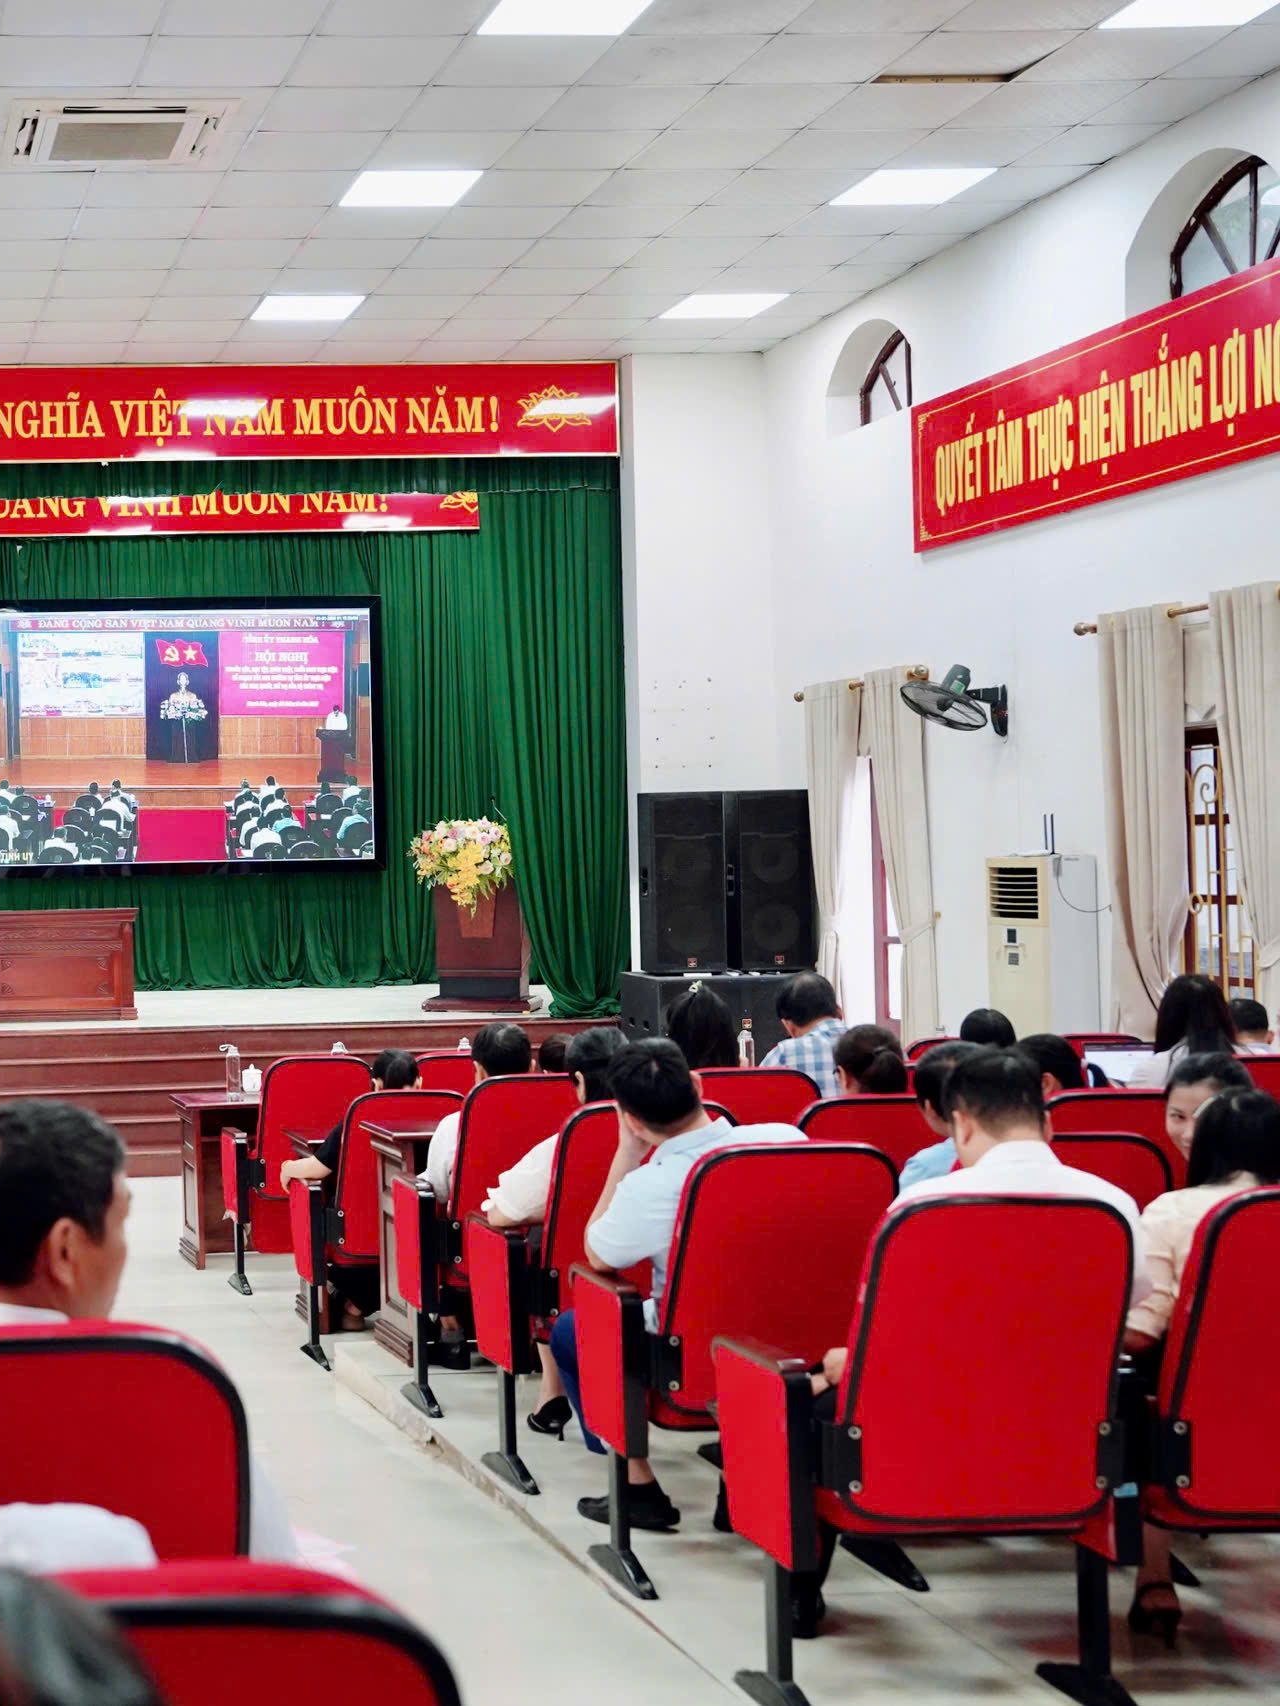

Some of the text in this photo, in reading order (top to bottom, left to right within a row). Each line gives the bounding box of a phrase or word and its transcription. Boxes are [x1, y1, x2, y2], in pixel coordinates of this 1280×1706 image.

[110, 388, 193, 447] VIỆT
[292, 385, 397, 436] MUÔN
[406, 385, 499, 434] NĂM!
[935, 413, 983, 517] QUYẾT
[987, 409, 1023, 494] TÂM
[1027, 394, 1074, 490] THỰC
[1079, 369, 1126, 475] HIỆN
[1130, 333, 1204, 449] THẮNG
[1209, 328, 1247, 437] LỢI
